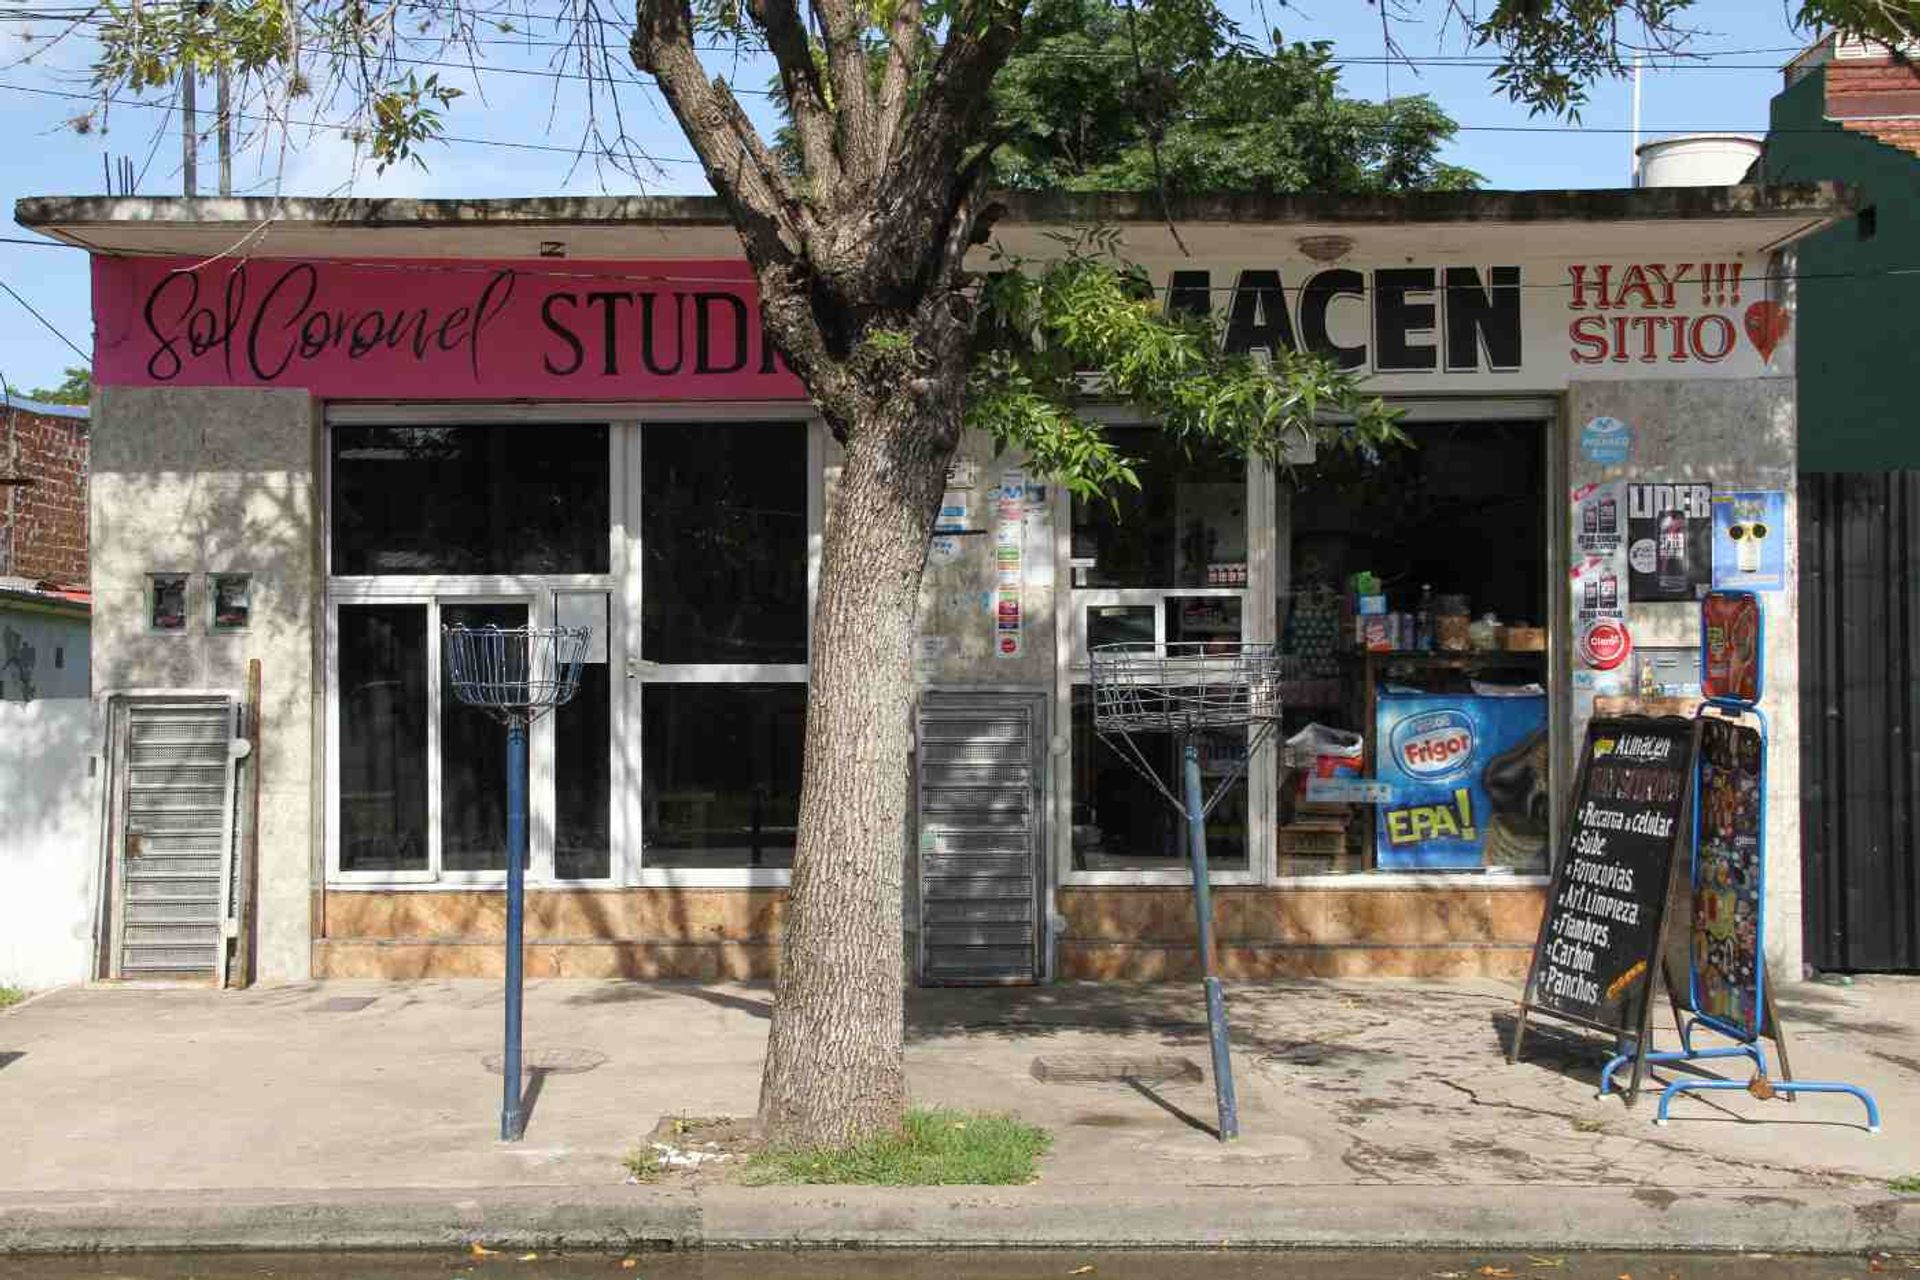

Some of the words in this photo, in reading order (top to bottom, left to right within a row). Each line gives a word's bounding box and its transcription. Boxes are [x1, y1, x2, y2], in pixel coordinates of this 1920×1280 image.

[143, 265, 247, 381] Sol
[248, 263, 515, 382] Coronel
[541, 290, 778, 376] STUDI
[1568, 313, 1736, 364] SITIO
[1590, 635, 1618, 647] Claro
[1404, 733, 1470, 765] Frigor
[1386, 787, 1478, 845] EPA!
